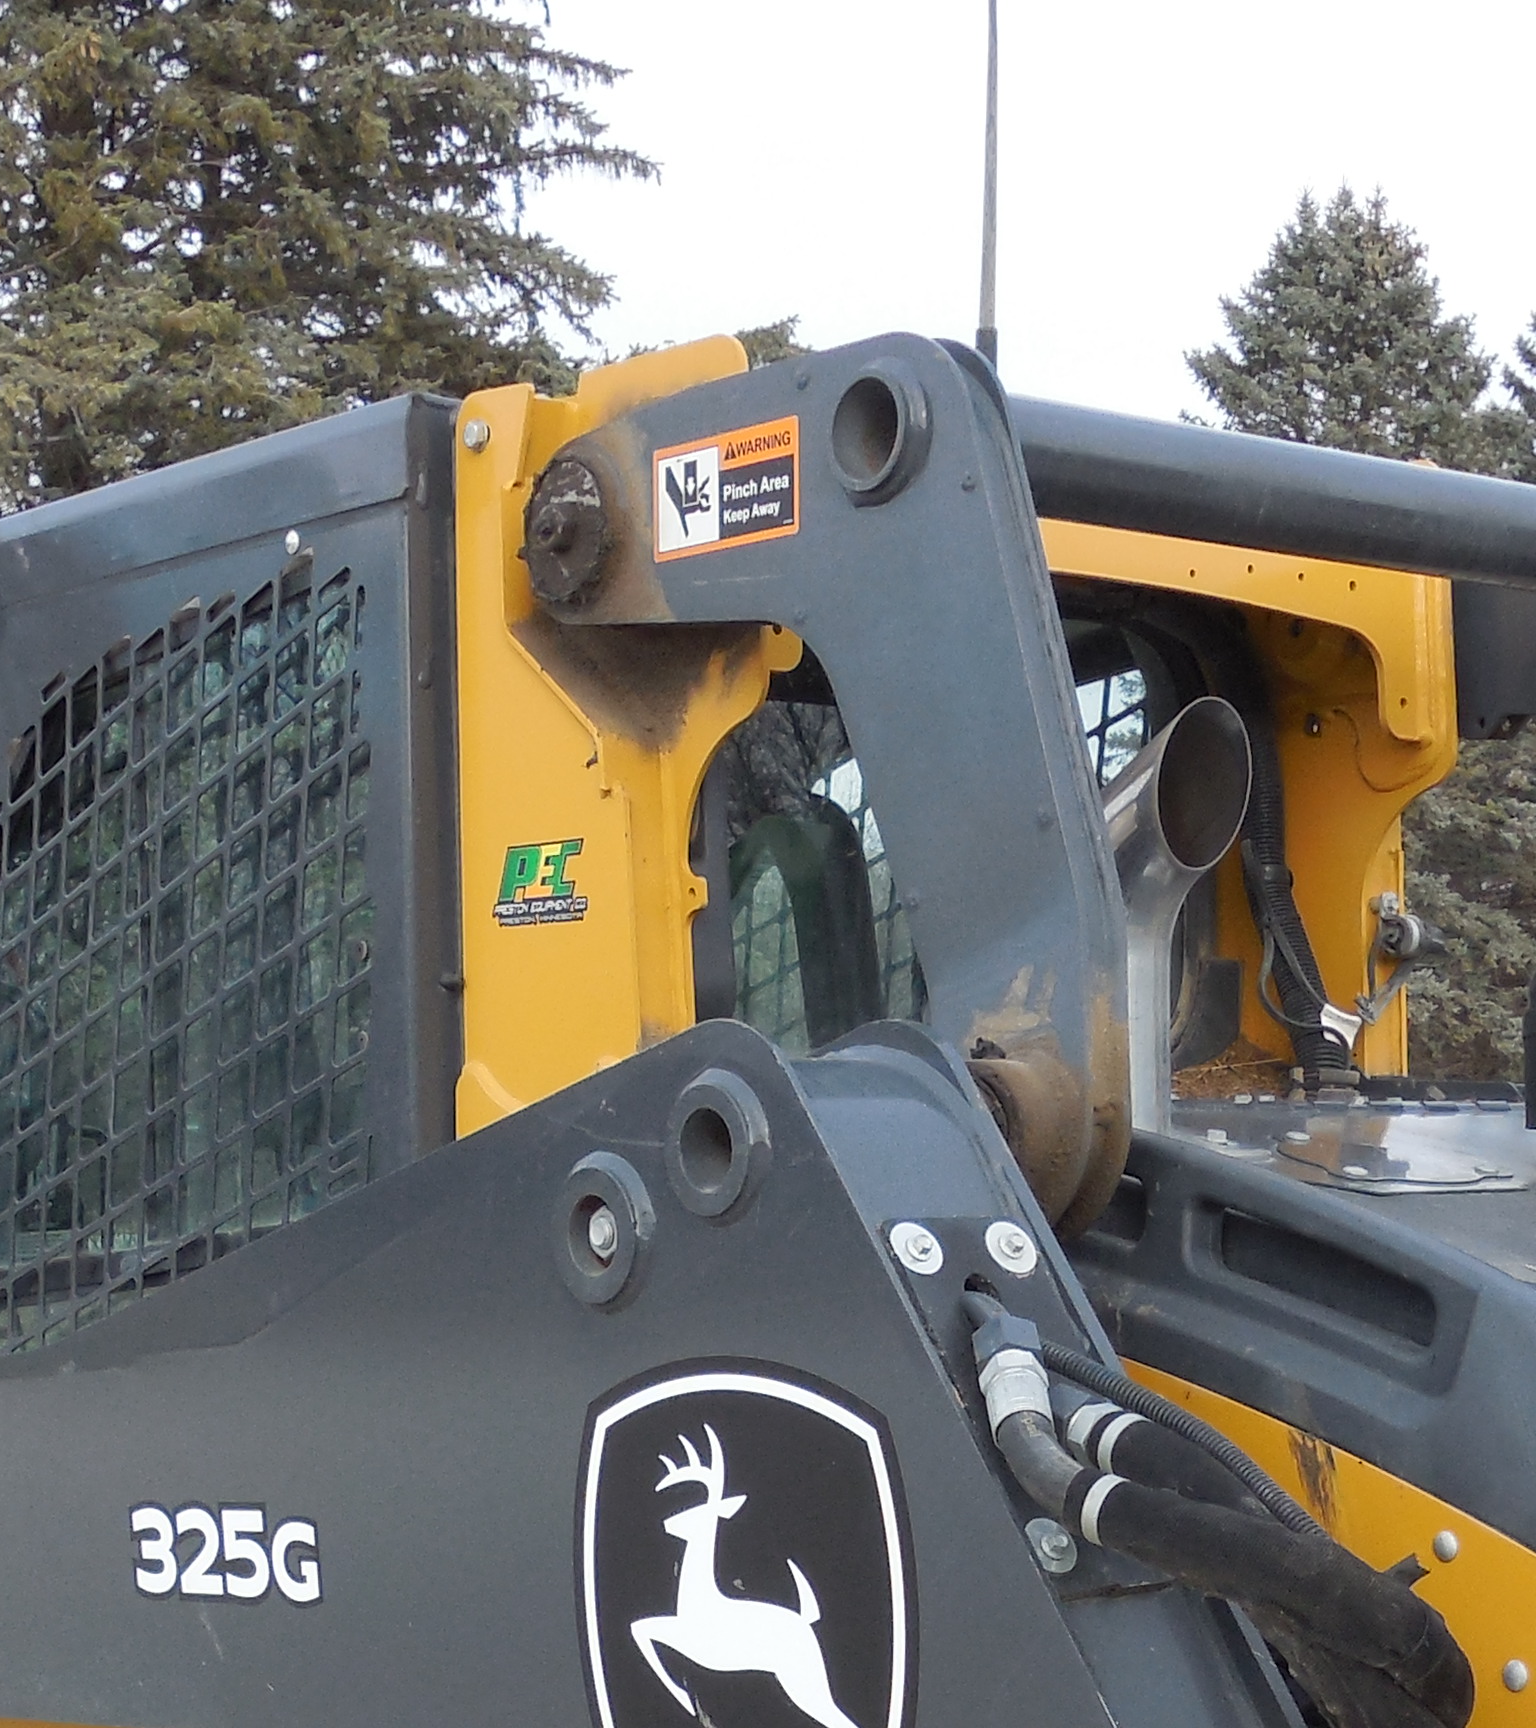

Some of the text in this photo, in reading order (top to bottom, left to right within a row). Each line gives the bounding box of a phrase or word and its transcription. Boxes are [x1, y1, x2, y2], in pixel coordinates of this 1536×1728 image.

[736, 431, 791, 457] WARNING
[723, 474, 790, 502] Pinch Area
[723, 500, 781, 525] Keep Away
[498, 838, 584, 903] PEC
[131, 1507, 321, 1602] 325G
